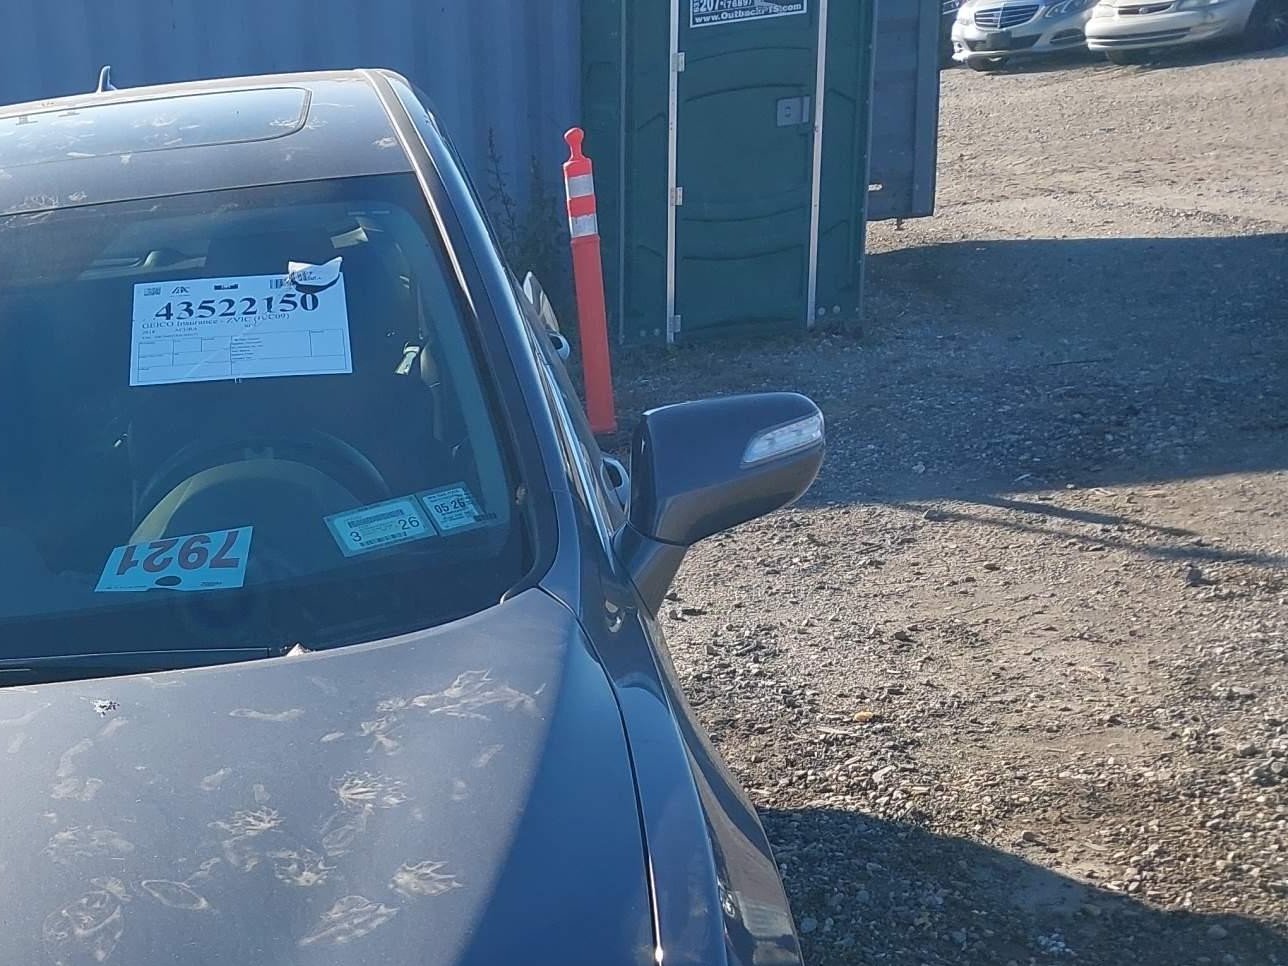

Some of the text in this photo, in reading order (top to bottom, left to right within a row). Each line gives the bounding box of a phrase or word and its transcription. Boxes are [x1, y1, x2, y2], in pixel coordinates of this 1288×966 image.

[154, 291, 319, 320] 43522150
[350, 531, 362, 542] 3
[398, 516, 420, 530] 26
[116, 532, 240, 575] 7921
